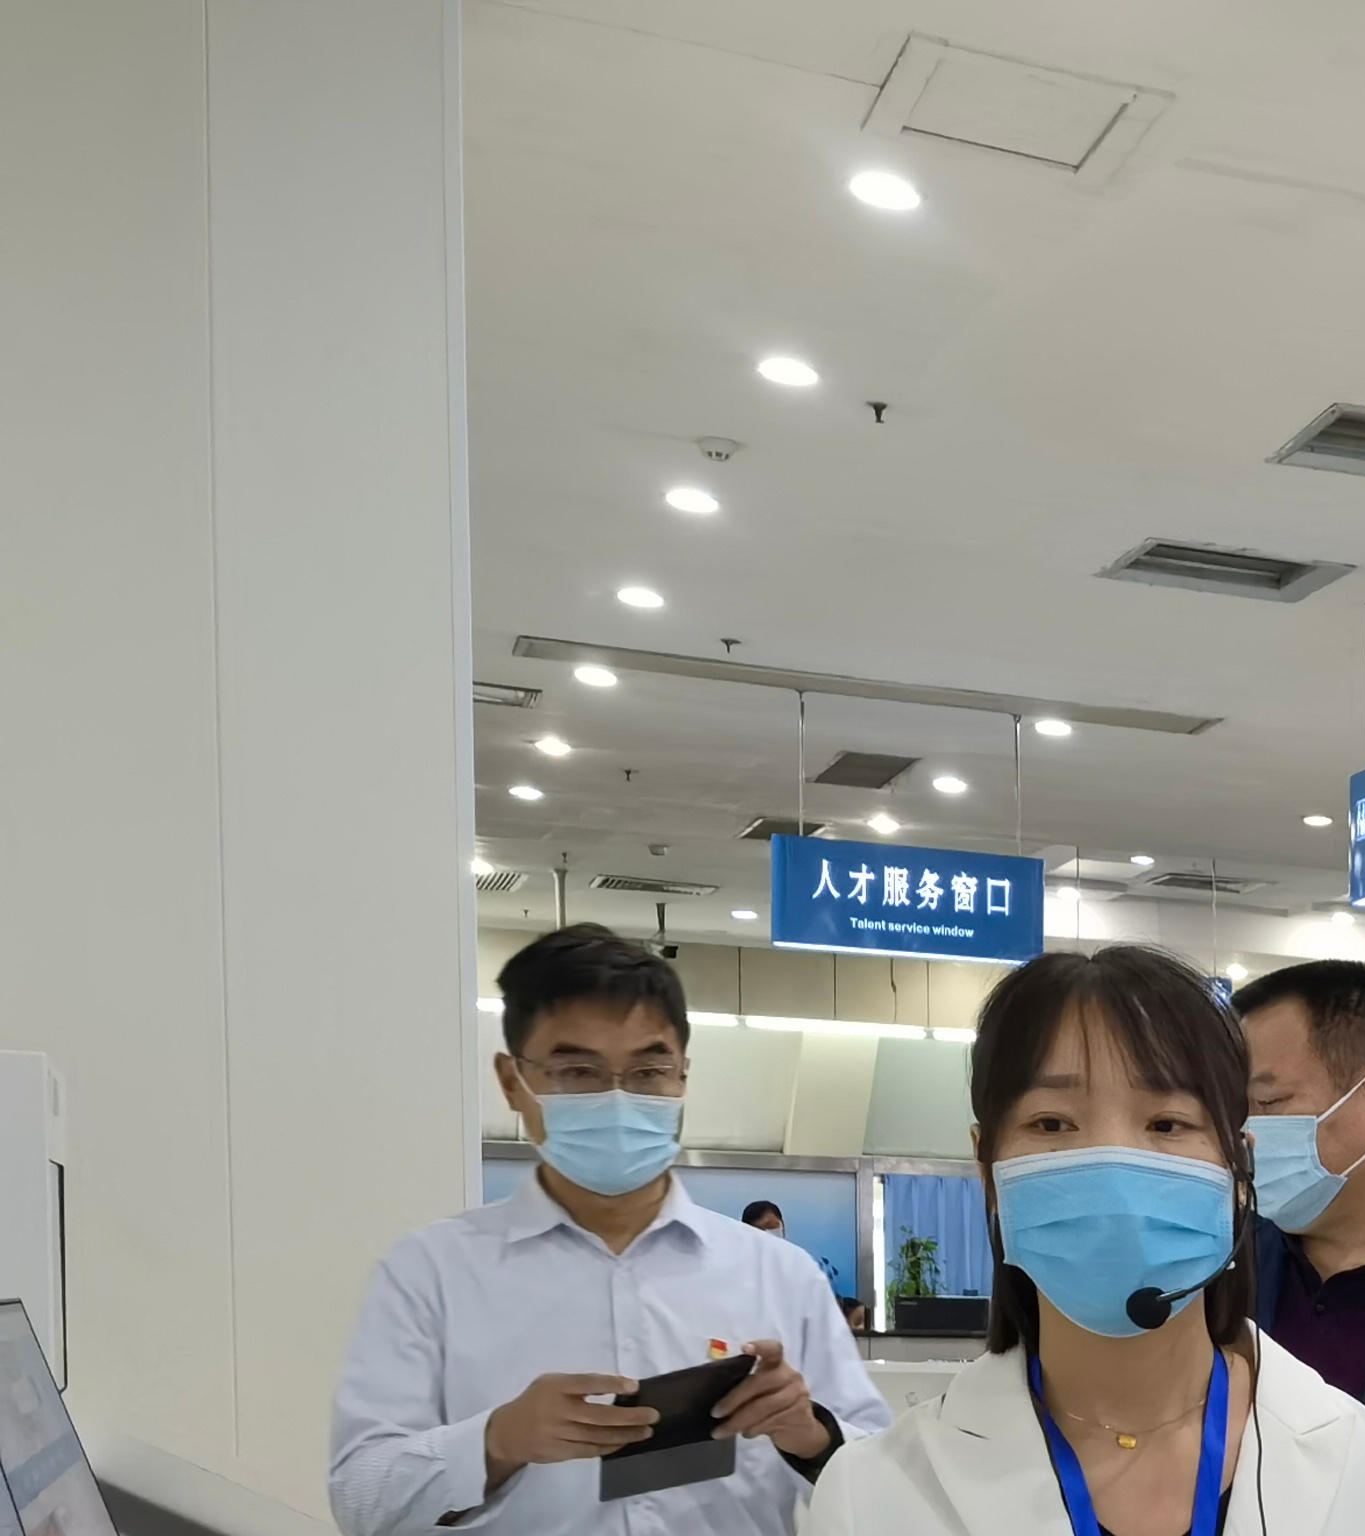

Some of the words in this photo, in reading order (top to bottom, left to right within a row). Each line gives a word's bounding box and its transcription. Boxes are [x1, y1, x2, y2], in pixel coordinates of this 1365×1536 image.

[812, 858, 1012, 917] 人才服务窗口
[850, 917, 886, 932] Talent
[887, 921, 931, 935] service
[932, 926, 975, 939] window
